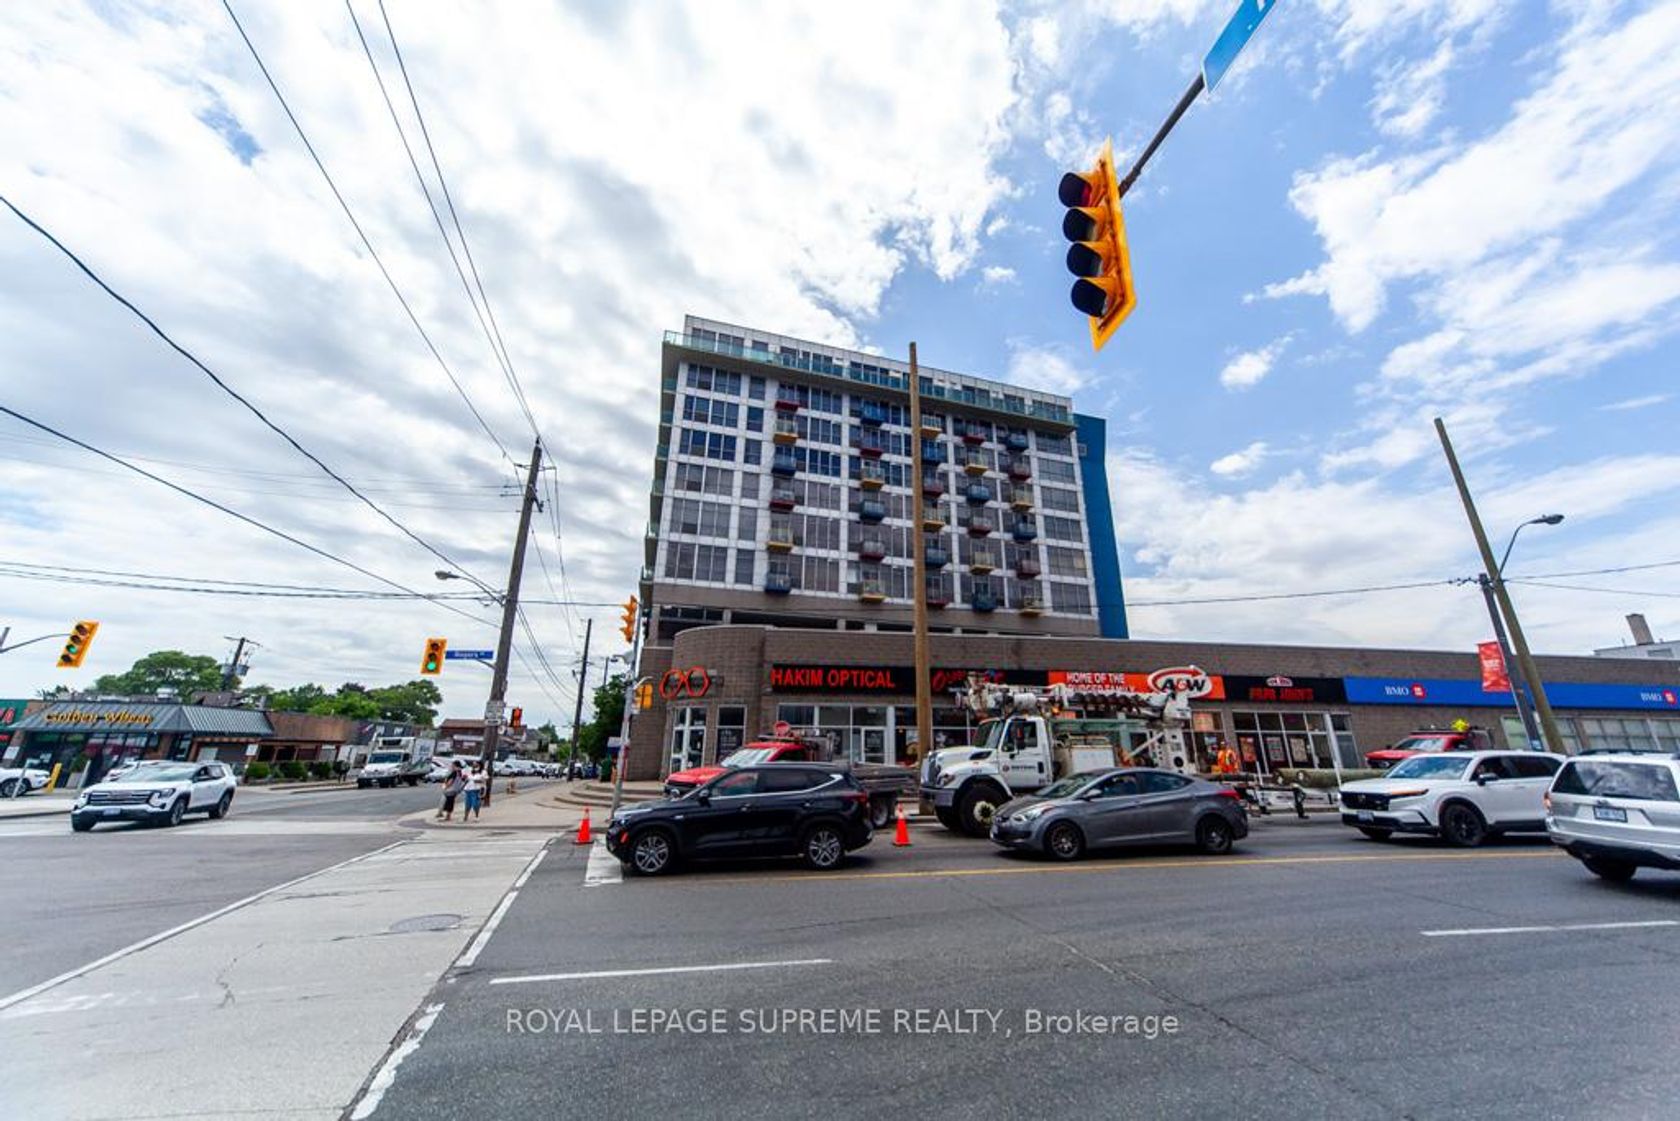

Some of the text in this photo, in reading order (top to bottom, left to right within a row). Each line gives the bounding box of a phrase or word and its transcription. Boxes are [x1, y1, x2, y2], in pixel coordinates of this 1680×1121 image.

[770, 667, 896, 689] HAKIM OPTICAL
[1066, 672, 1125, 684] HOME OF THE
[1384, 685, 1410, 696] BMO
